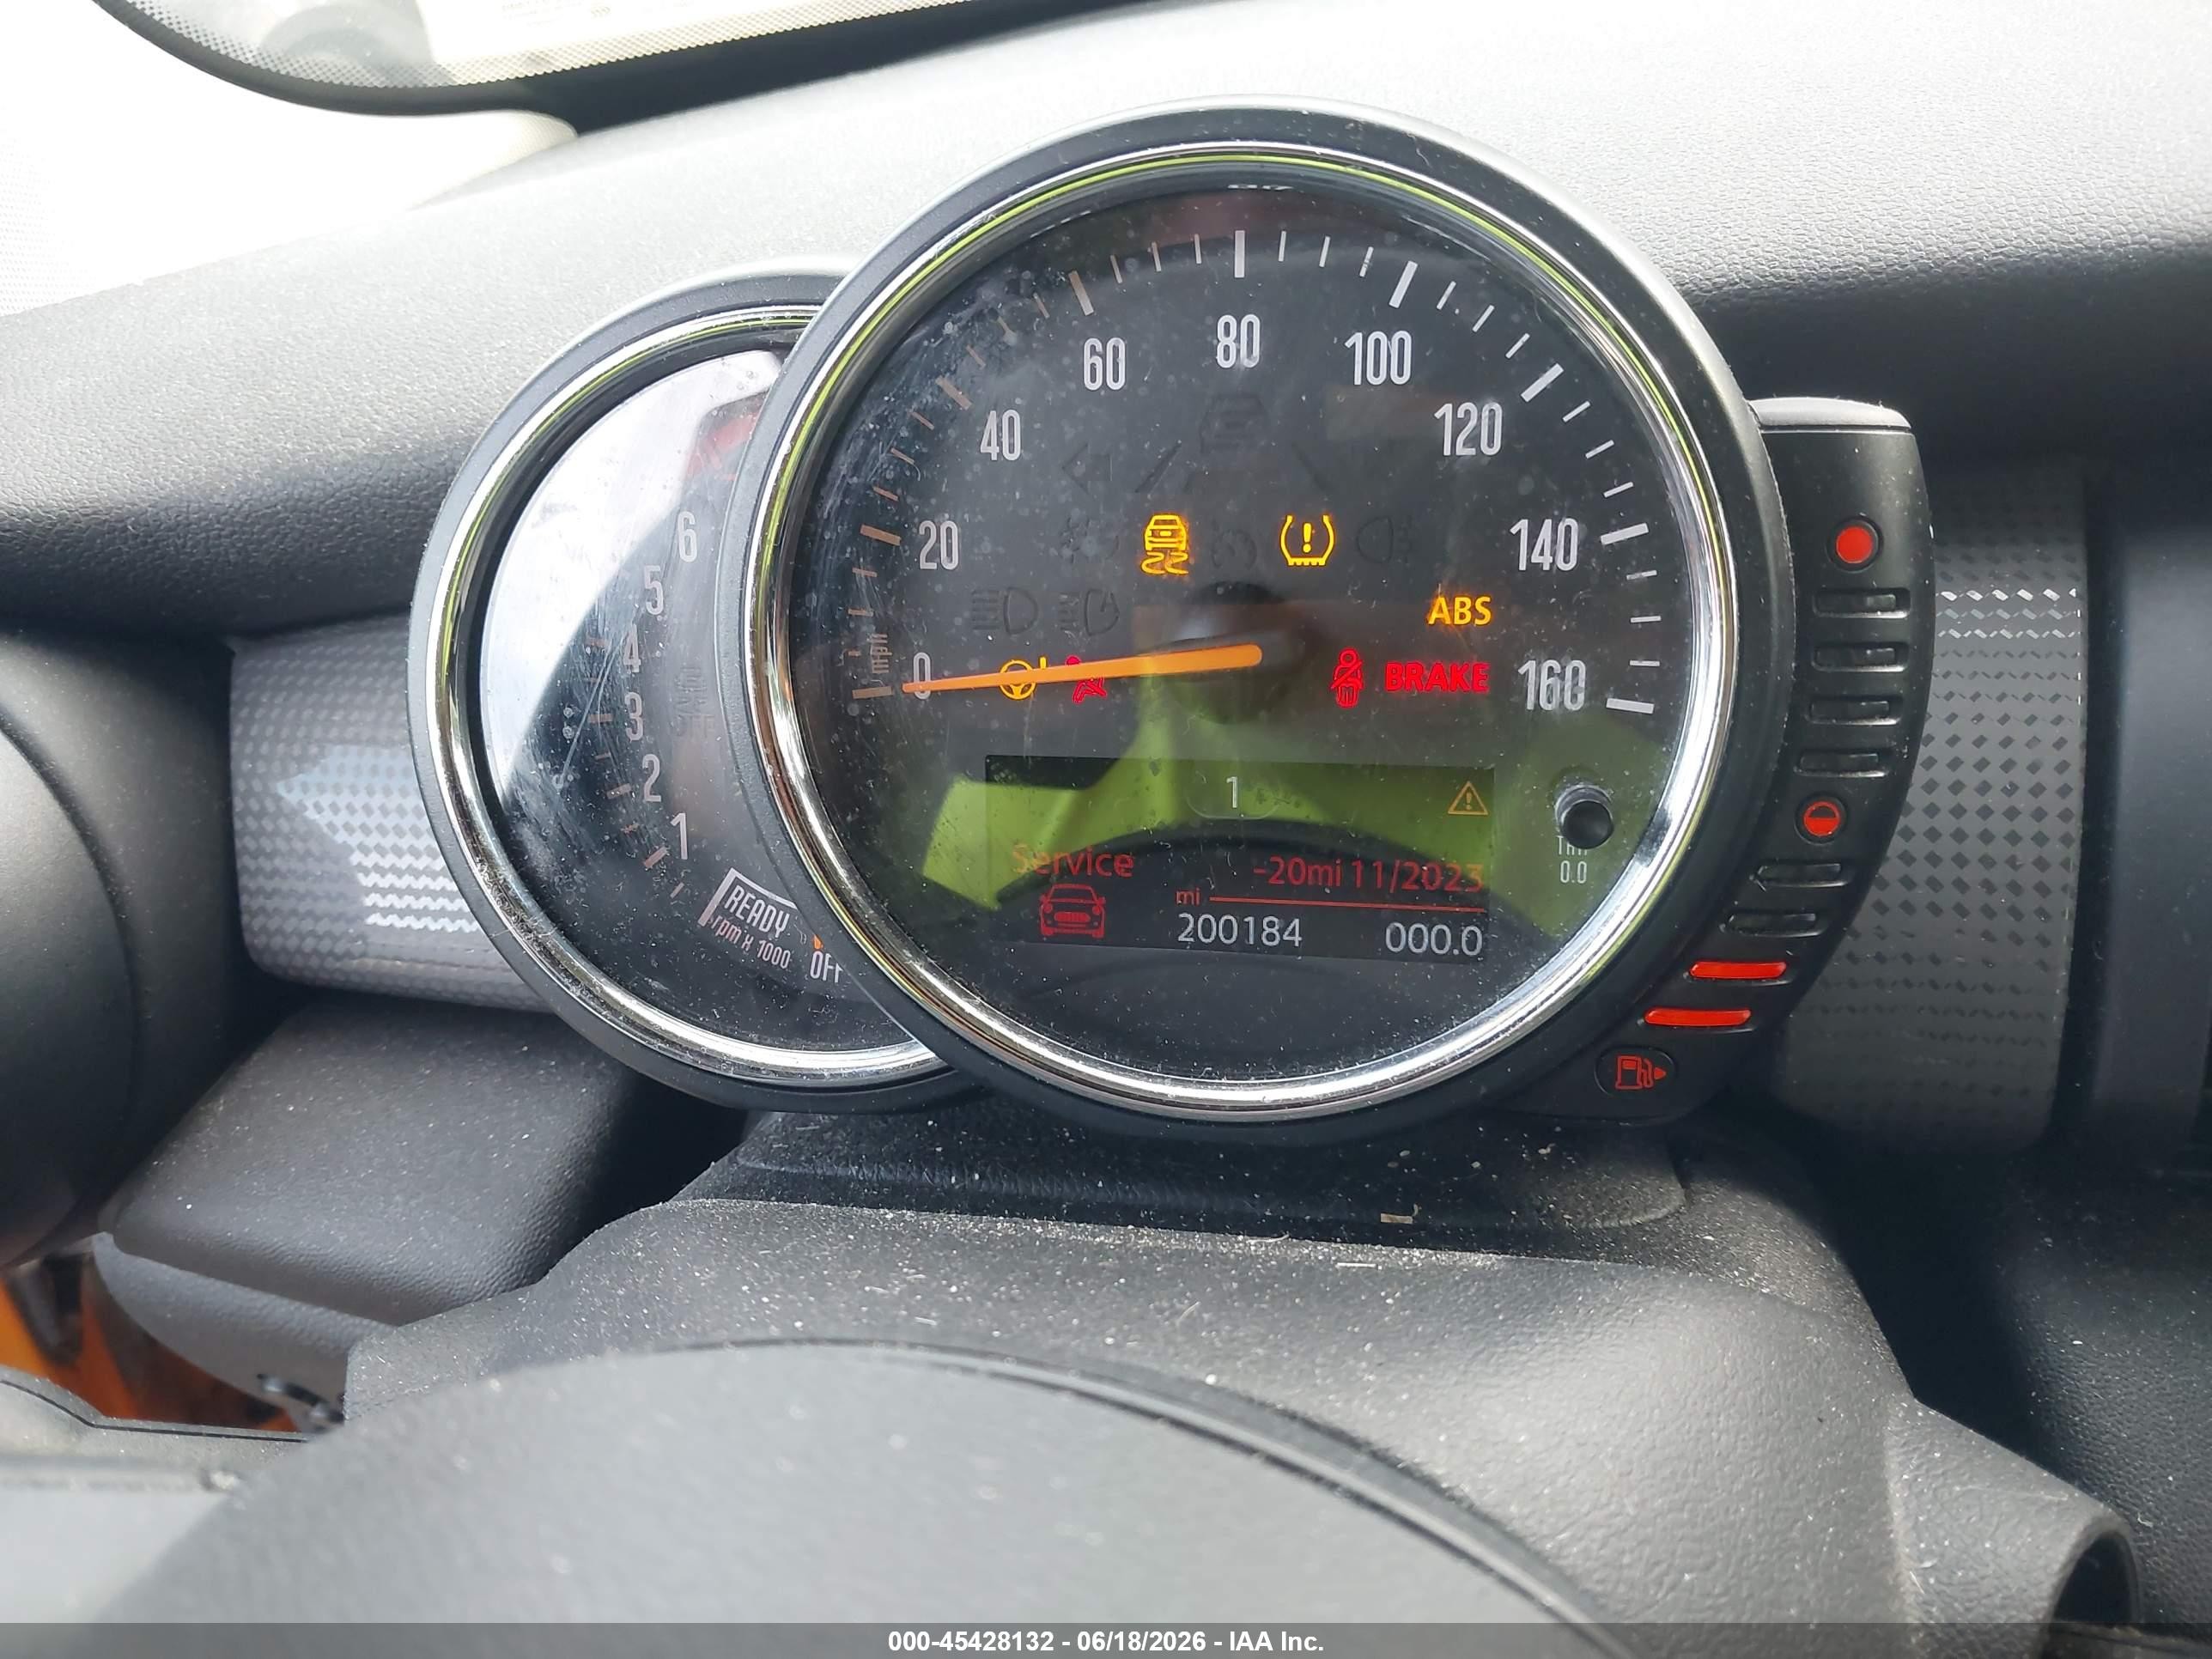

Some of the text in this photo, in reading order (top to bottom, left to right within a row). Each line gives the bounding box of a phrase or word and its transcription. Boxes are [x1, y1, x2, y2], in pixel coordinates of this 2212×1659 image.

[1084, 337, 1127, 391] 60
[1217, 314, 1261, 368] 80
[1345, 331, 1412, 385] 100
[980, 409, 1021, 461] 40
[1434, 403, 1503, 456] 120
[677, 511, 698, 562] 6
[919, 520, 958, 570] 20
[1510, 518, 1579, 571] 140
[643, 565, 664, 615] 5
[1428, 596, 1492, 626] ABS
[623, 623, 641, 673] 4
[913, 652, 932, 700] 0
[1384, 661, 1491, 692] BRAKE
[1518, 659, 1586, 711] 160
[624, 691, 644, 741] 3
[642, 754, 662, 802] 2
[1226, 776, 1238, 810] 1
[670, 811, 688, 860] 1
[1012, 844, 1135, 878] Service
[1560, 860, 1587, 884] 0.0
[724, 885, 790, 937] READY
[1176, 887, 1201, 906] mi
[758, 940, 791, 969] 1000
[1176, 911, 1484, 957] 200184 000.0
